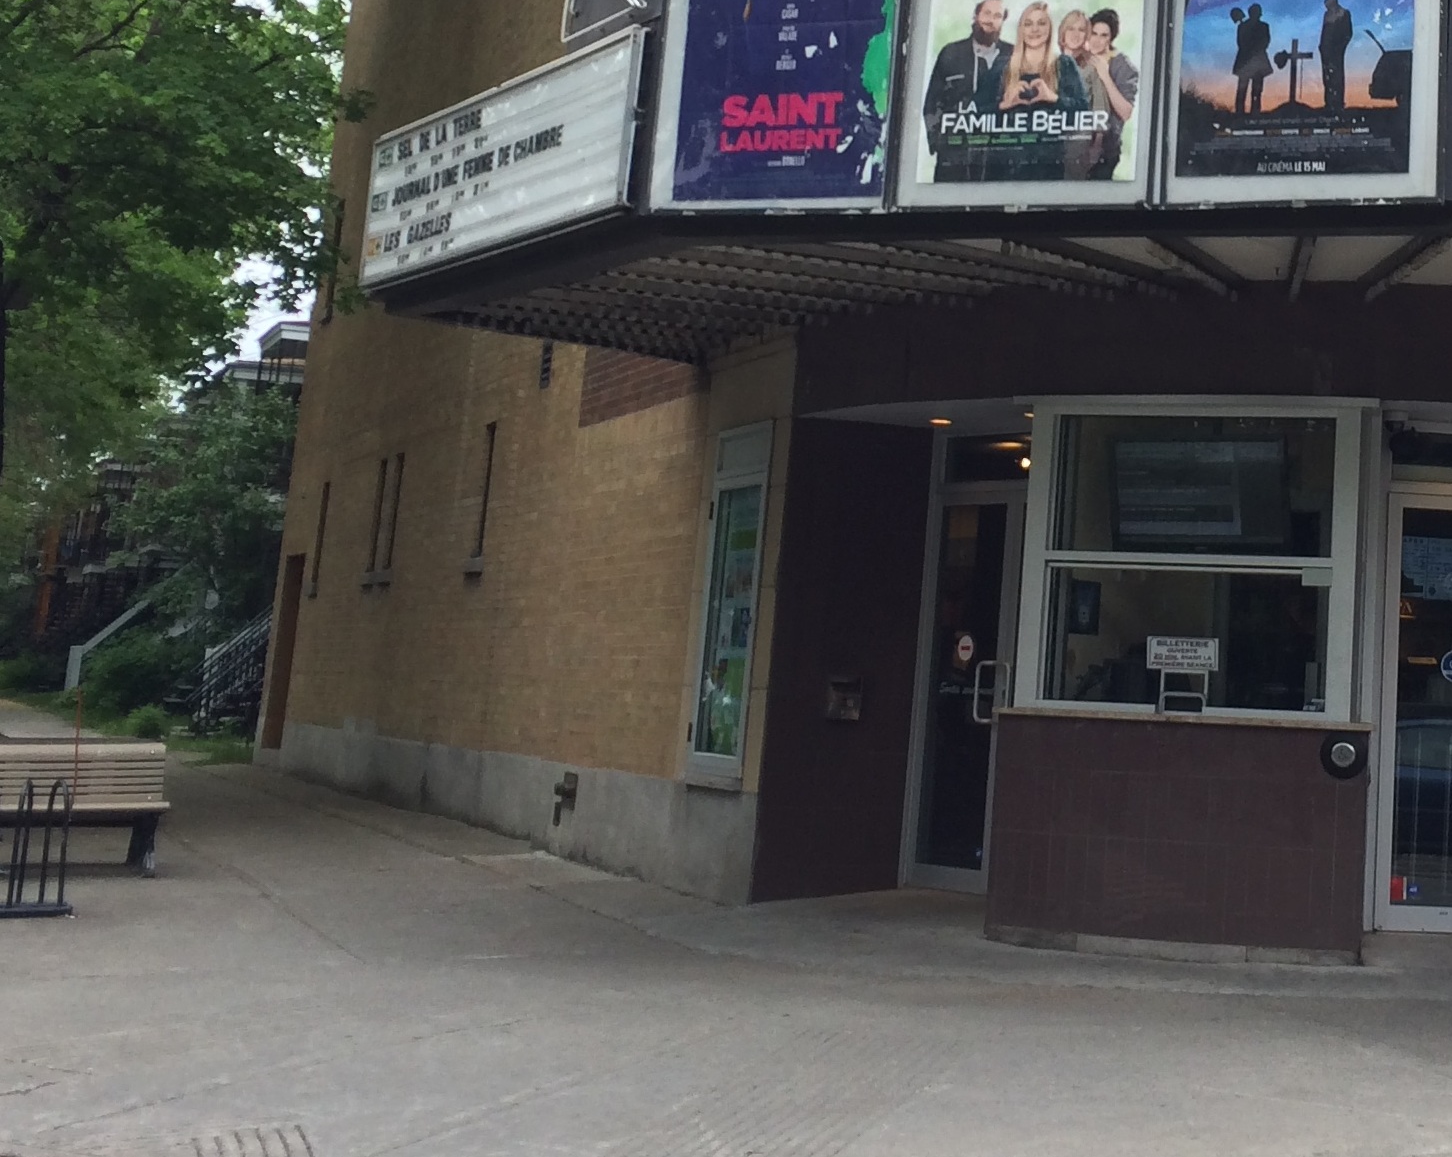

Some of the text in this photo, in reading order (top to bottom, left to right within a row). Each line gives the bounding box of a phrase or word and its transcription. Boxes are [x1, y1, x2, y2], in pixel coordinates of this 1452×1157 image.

[722, 91, 844, 127] SAINT
[958, 101, 978, 114] LA
[941, 109, 1109, 135] FAMILLE BÉLIER
[419, 130, 430, 152] DE
[435, 123, 447, 146] LA
[720, 128, 843, 152] LAURENT
[1312, 161, 1326, 172] MAI
[383, 230, 401, 252] LES
